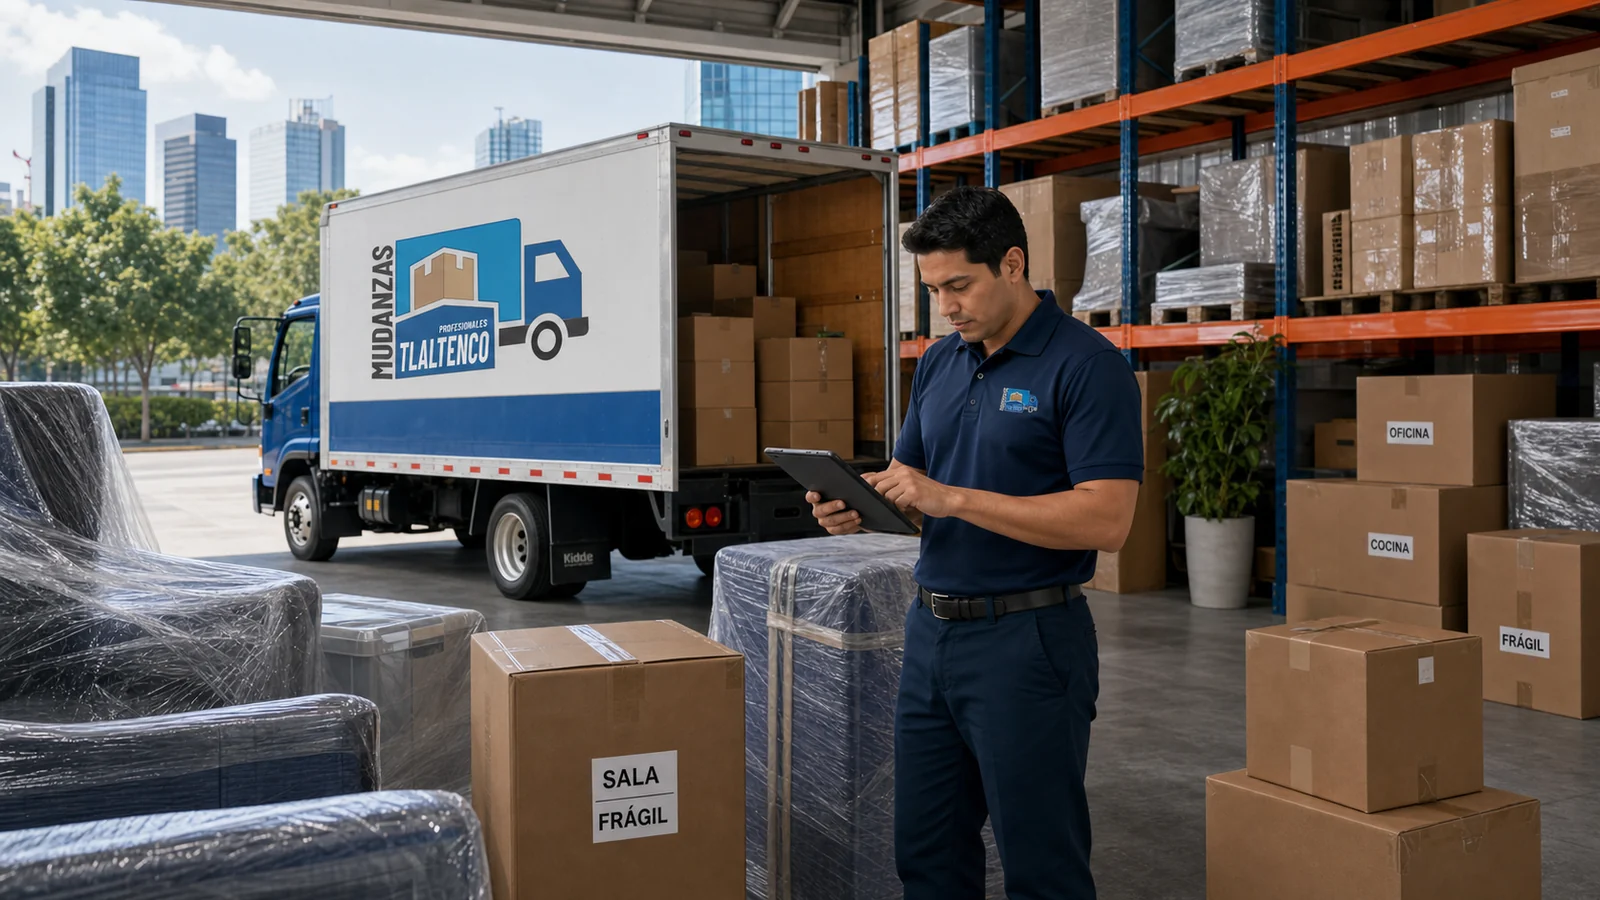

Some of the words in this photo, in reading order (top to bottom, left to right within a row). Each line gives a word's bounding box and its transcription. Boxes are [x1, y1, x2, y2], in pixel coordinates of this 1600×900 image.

[371, 244, 393, 380] MUDANZAS
[400, 331, 490, 372] TLALTENCO
[1389, 427, 1430, 439] OFICINA
[1370, 538, 1410, 553] COCINA
[563, 551, 594, 564] Kidde
[1502, 632, 1545, 652] FRÁGIL
[602, 765, 660, 789] SALA
[598, 804, 669, 831] FRÁGIL
